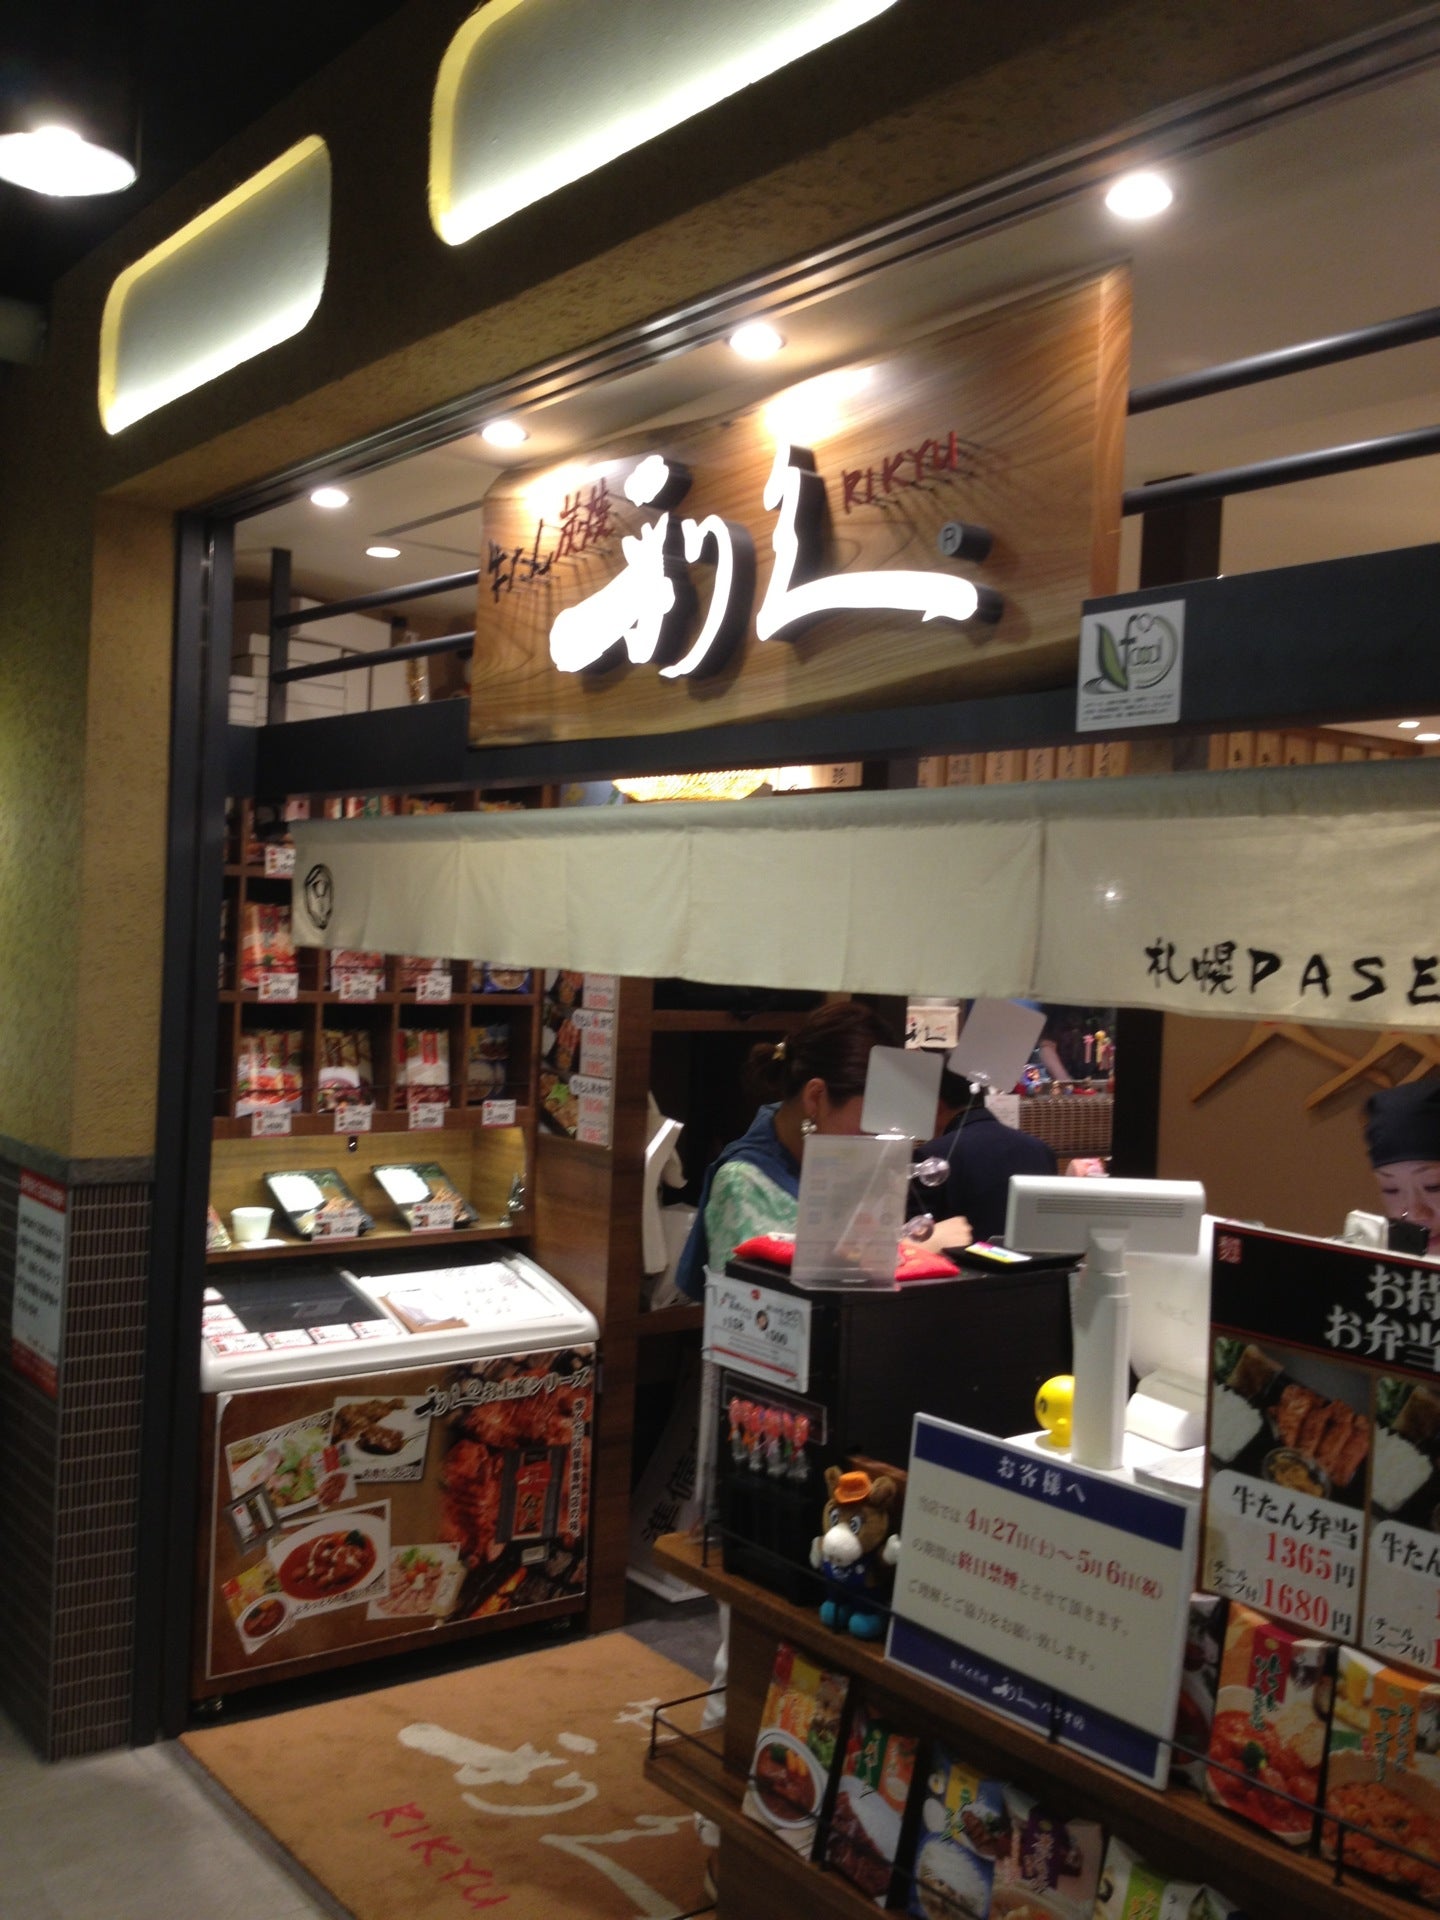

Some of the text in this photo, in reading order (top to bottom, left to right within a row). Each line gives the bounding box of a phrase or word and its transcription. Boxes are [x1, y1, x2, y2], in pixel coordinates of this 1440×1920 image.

[841, 430, 959, 515] RIKYU
[548, 455, 980, 678] 利久
[997, 1455, 1087, 1502] お客様へ
[1232, 1484, 1358, 1550] 牛たん弁当
